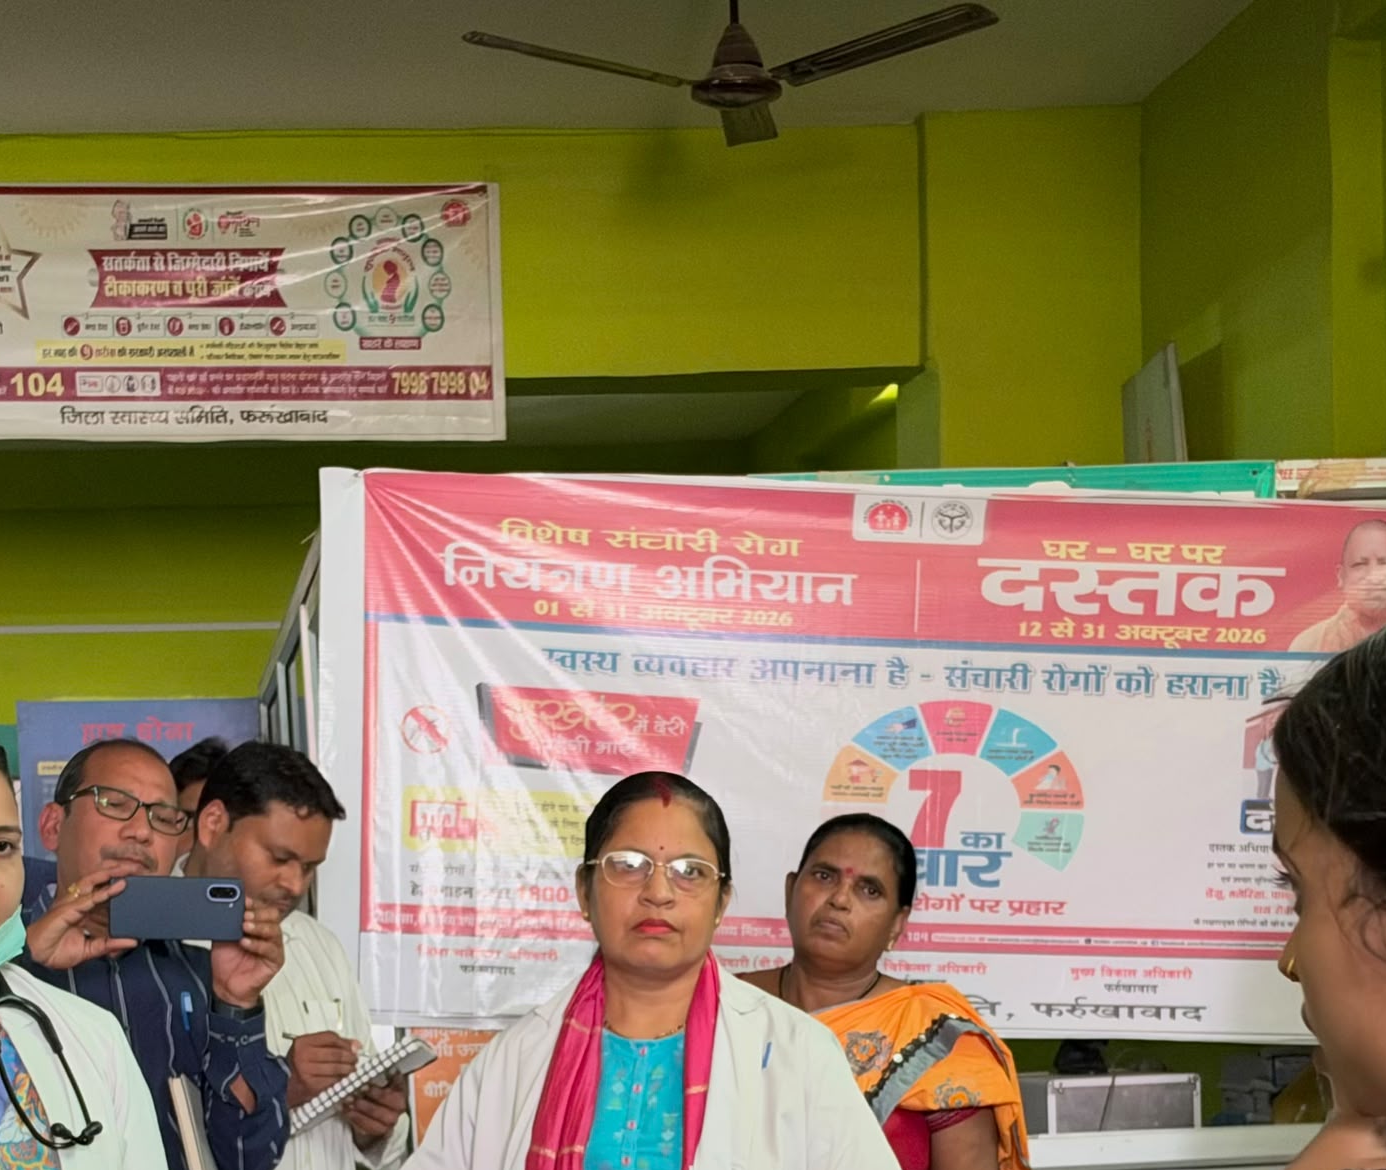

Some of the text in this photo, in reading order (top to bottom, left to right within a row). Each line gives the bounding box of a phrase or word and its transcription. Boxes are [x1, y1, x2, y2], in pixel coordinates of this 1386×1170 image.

[103, 252, 150, 272] सतर्कता
[153, 253, 165, 272] से
[103, 275, 170, 297] टीकाकरण
[11, 372, 65, 397] 104
[60, 406, 105, 425] जिला
[497, 518, 802, 558] विशेष संचारी रोग
[1042, 540, 1090, 561] घर
[1128, 542, 1174, 563] घर
[1181, 544, 1226, 565] पर
[655, 555, 859, 606] अभियान
[977, 558, 1287, 619] दस्तक
[533, 600, 559, 616] 01
[570, 600, 597, 619] से
[740, 610, 794, 627] 2026
[1019, 617, 1267, 650] 12 से 31 अक्टूबर 2026
[542, 648, 621, 674] स्वस्थ
[632, 653, 739, 678] व्यवहार
[749, 655, 877, 686] अपनाना
[886, 655, 910, 689] है
[944, 660, 1034, 690] संचारी
[1042, 660, 1110, 694] रोगों
[1116, 665, 1155, 696] को
[1164, 674, 1251, 698] हराना
[1259, 667, 1282, 699] है
[138, 716, 196, 742] धोना
[653, 714, 689, 735] देरी
[908, 769, 1006, 849] 7 का
[1238, 842, 1270, 853] अभिया
[969, 897, 1002, 917] पर
[1008, 898, 1066, 918] प्रहार
[1070, 965, 1193, 981] मुख्य विकास अधिकारी
